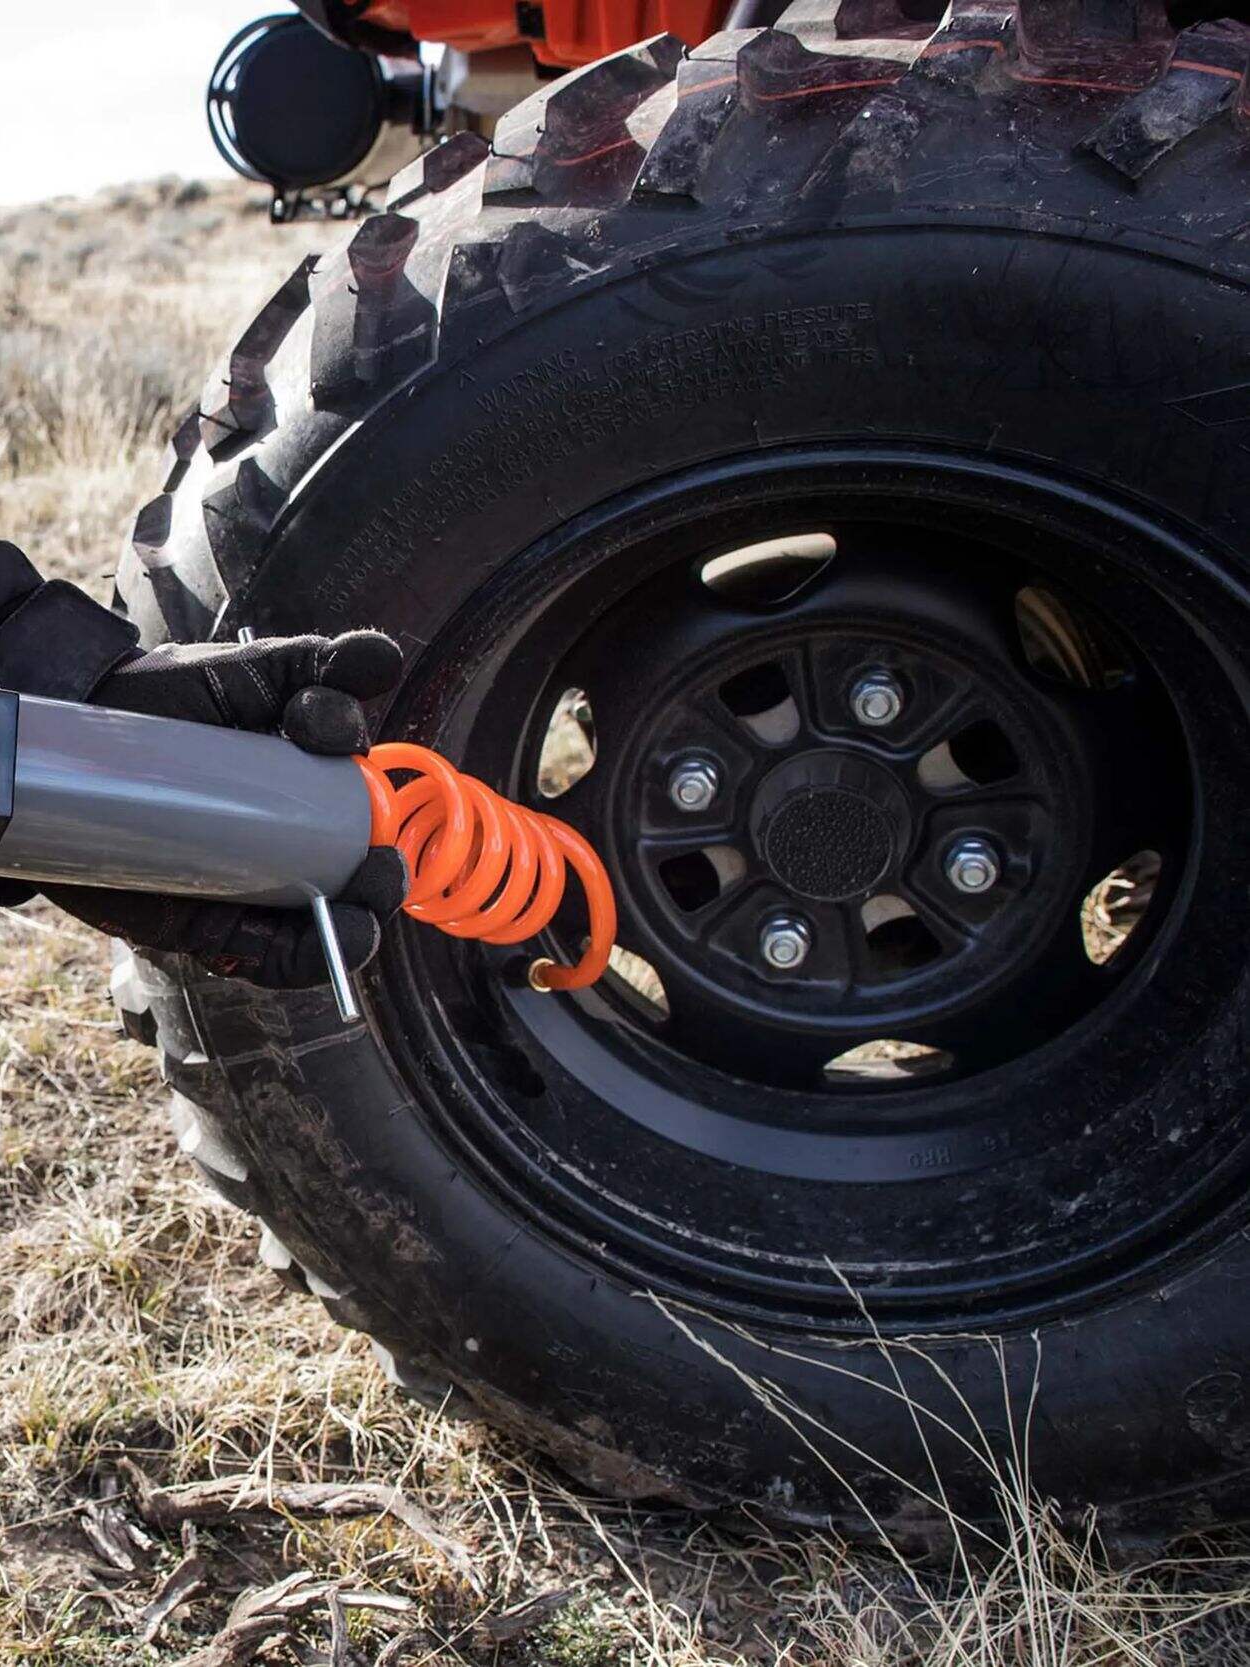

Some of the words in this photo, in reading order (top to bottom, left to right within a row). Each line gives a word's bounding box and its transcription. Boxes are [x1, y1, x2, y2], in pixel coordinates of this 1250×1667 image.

[601, 346, 641, 375] FOR
[646, 316, 758, 357] OPERATING
[474, 348, 578, 412] WARNING
